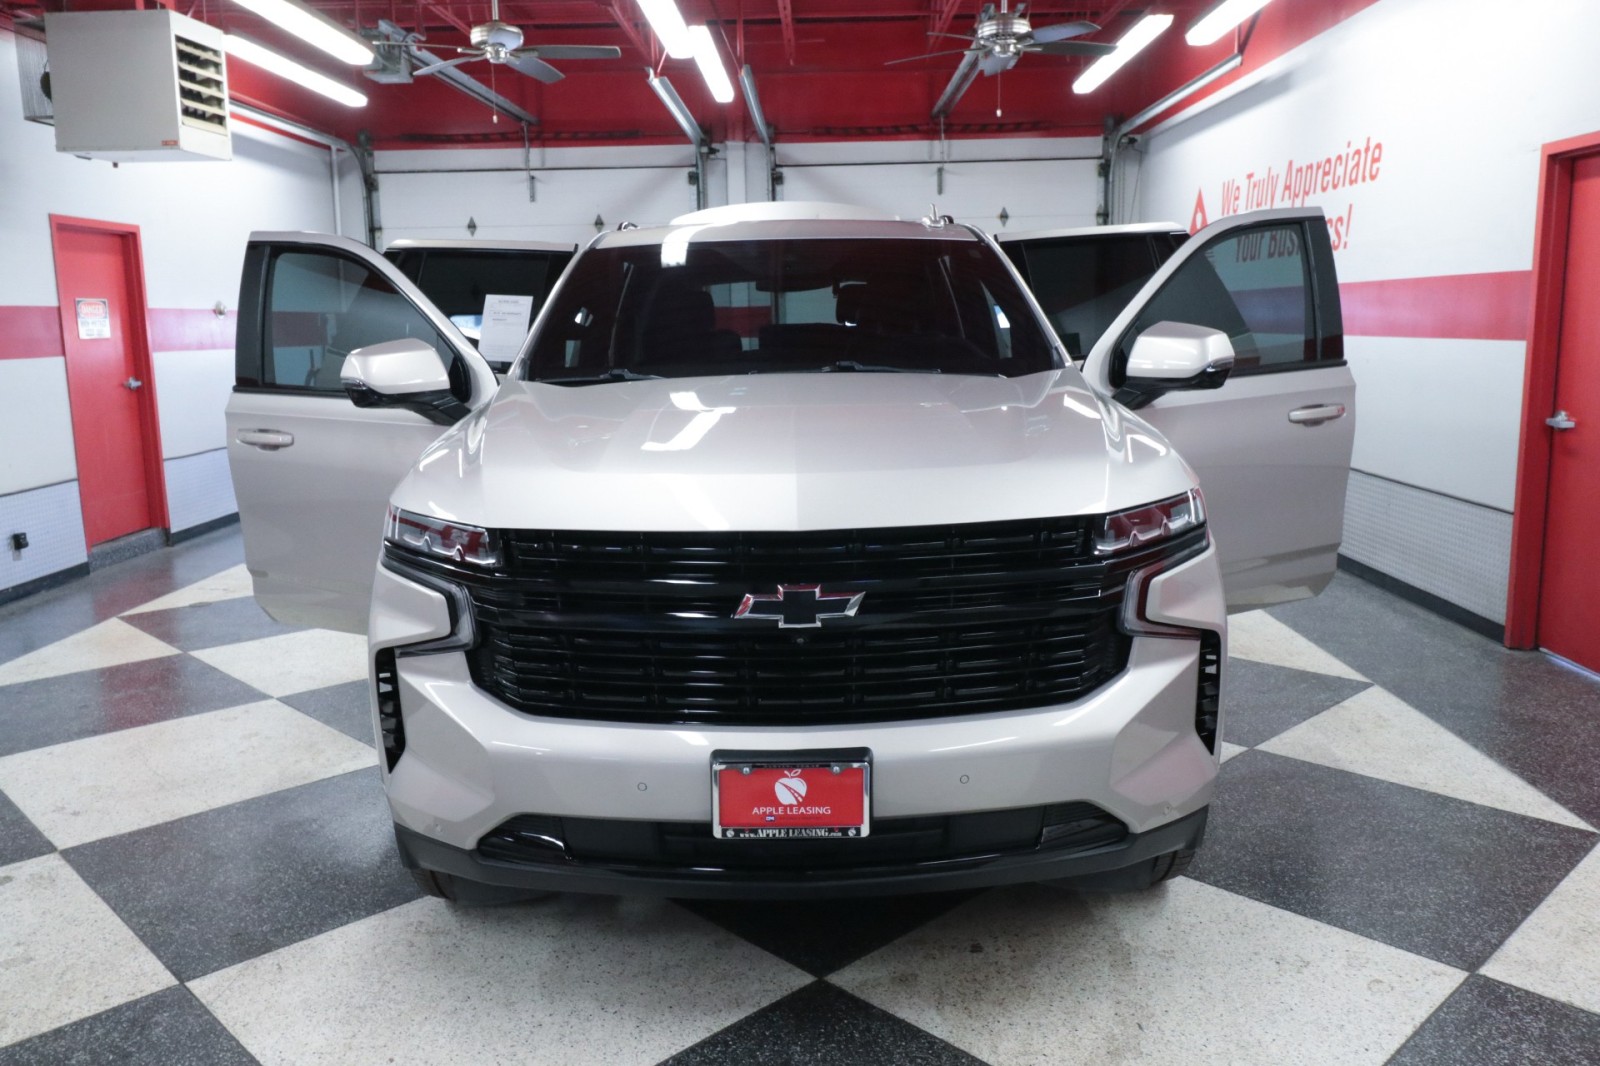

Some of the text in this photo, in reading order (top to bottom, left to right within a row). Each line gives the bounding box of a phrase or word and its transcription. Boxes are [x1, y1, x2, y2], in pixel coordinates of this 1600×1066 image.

[1221, 136, 1383, 216] We Truly Appreciate
[752, 806, 831, 815] APPLE LEASING
